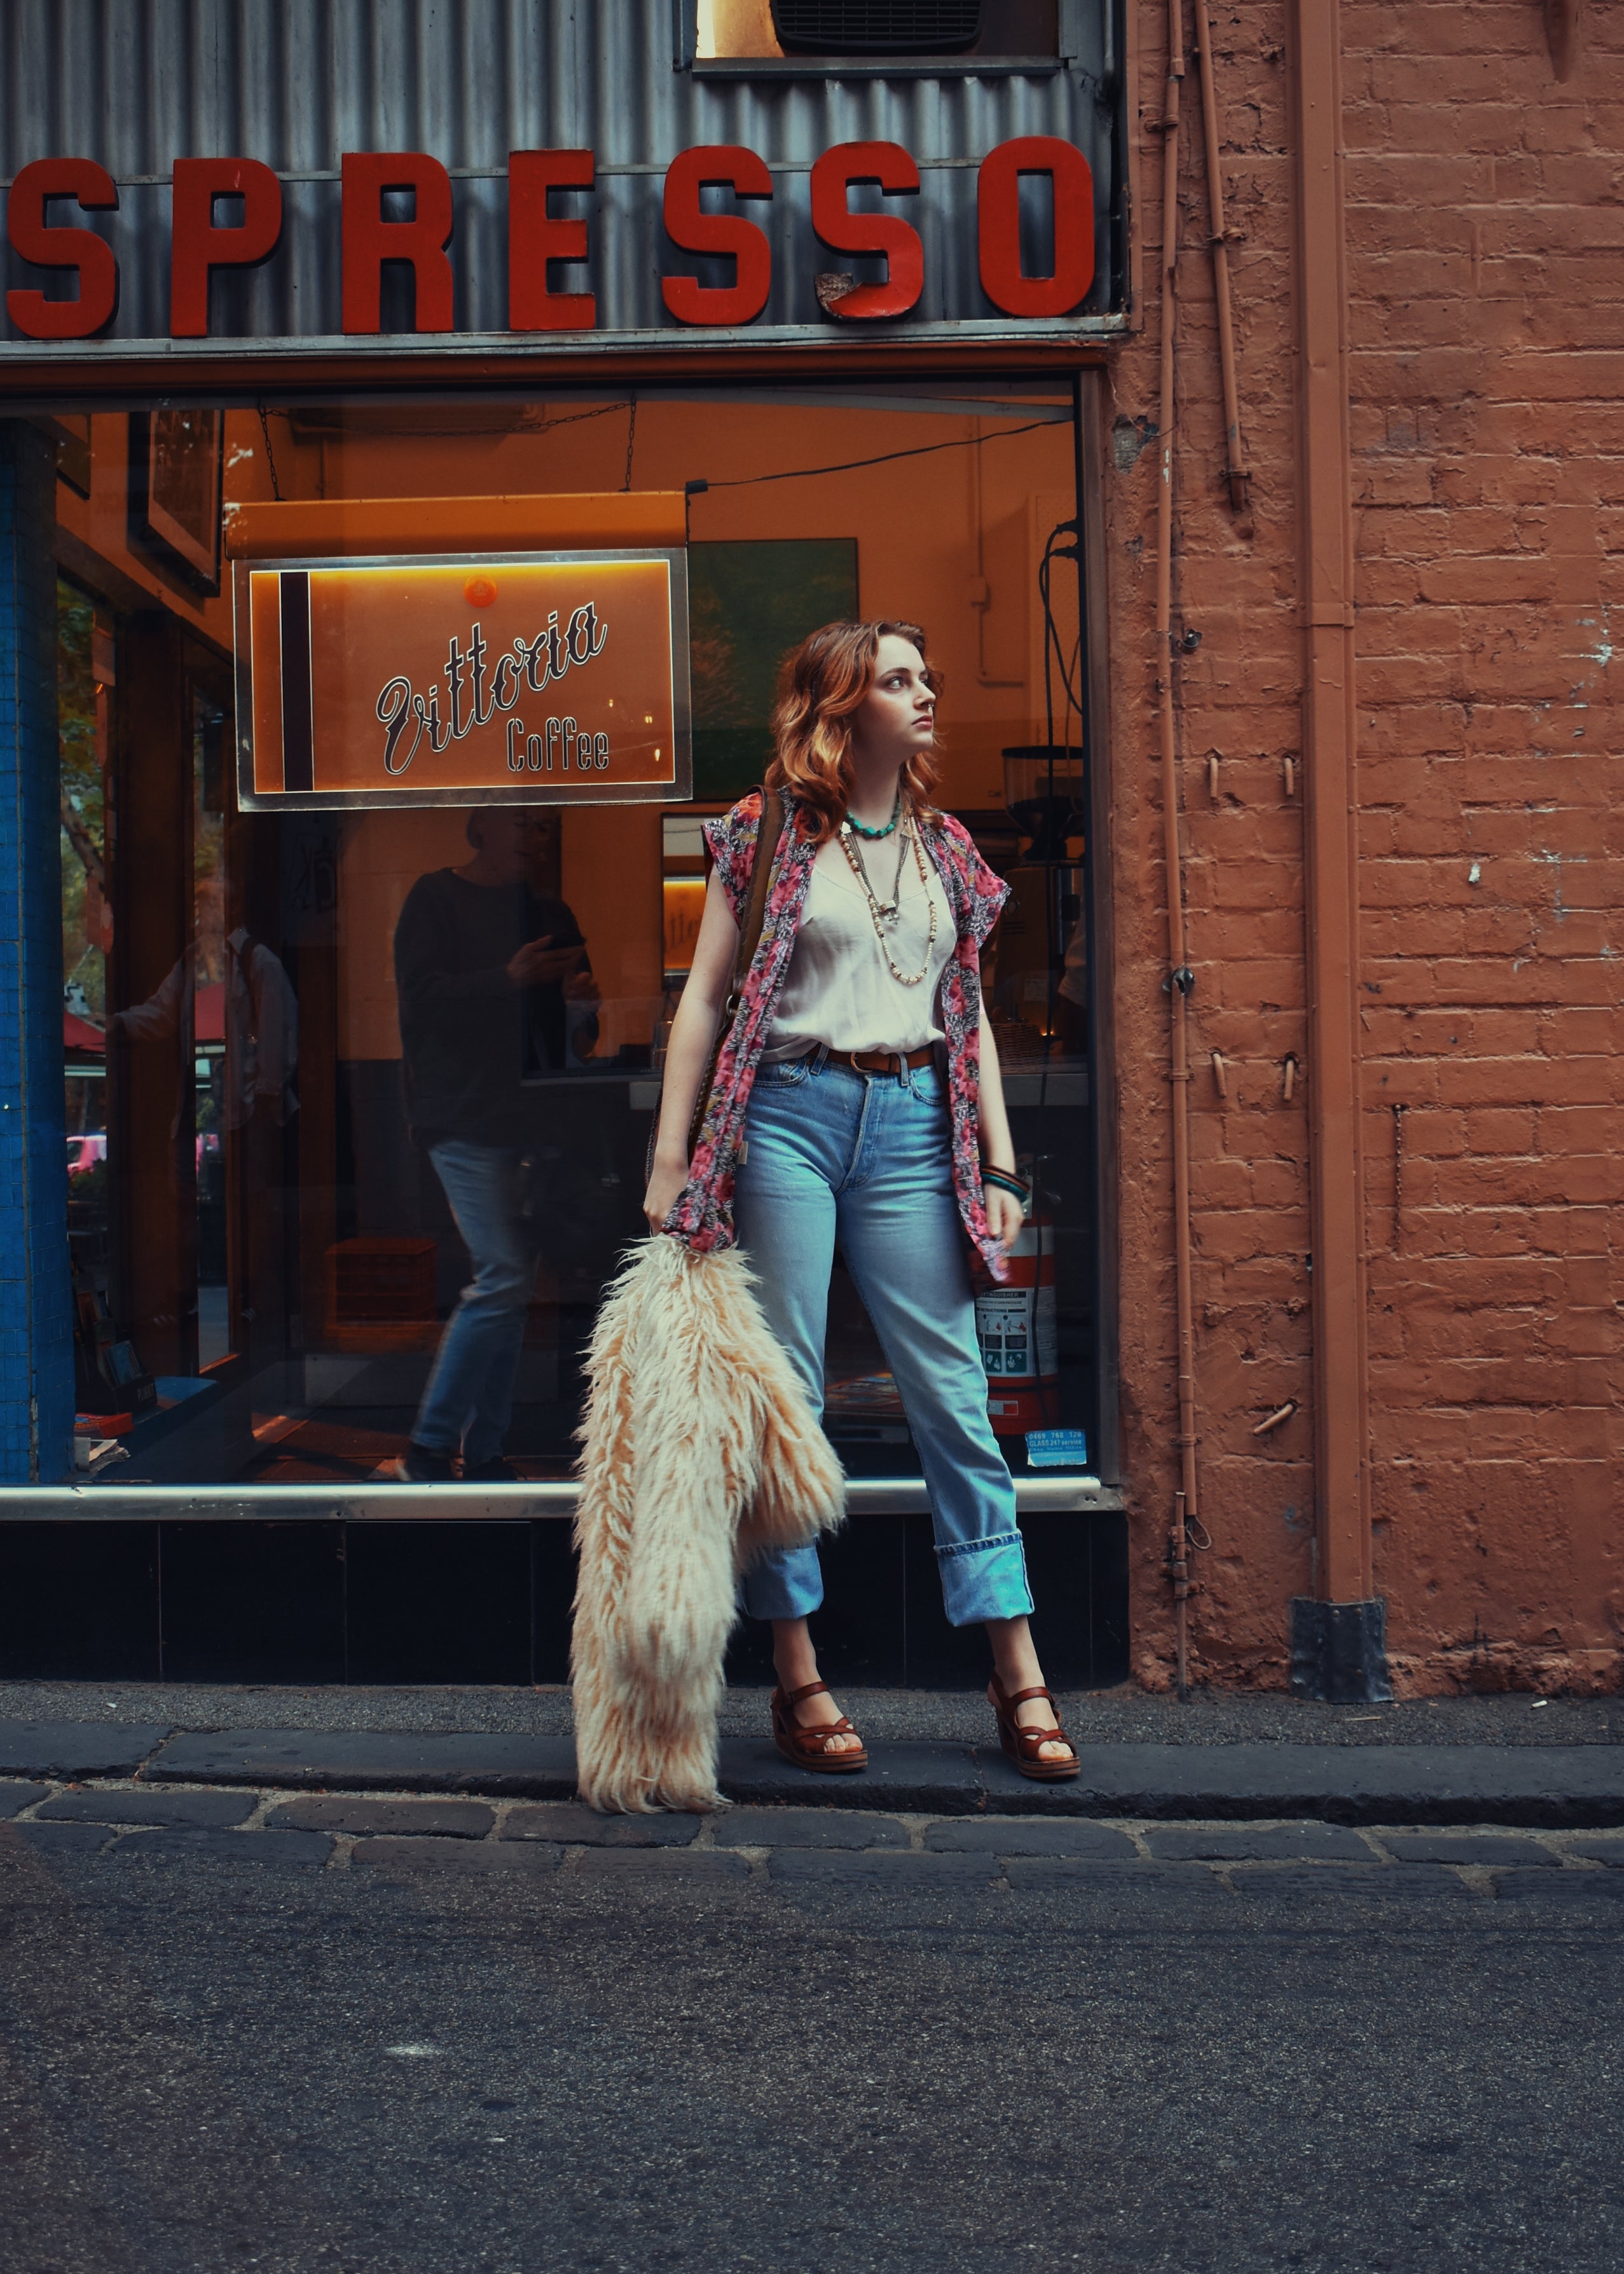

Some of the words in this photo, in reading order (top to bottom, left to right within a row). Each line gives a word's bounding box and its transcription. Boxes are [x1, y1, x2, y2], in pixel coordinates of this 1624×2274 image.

[6, 135, 1095, 339] SPRESSO
[376, 602, 608, 775] Vittoria
[506, 716, 610, 772] Coffee
